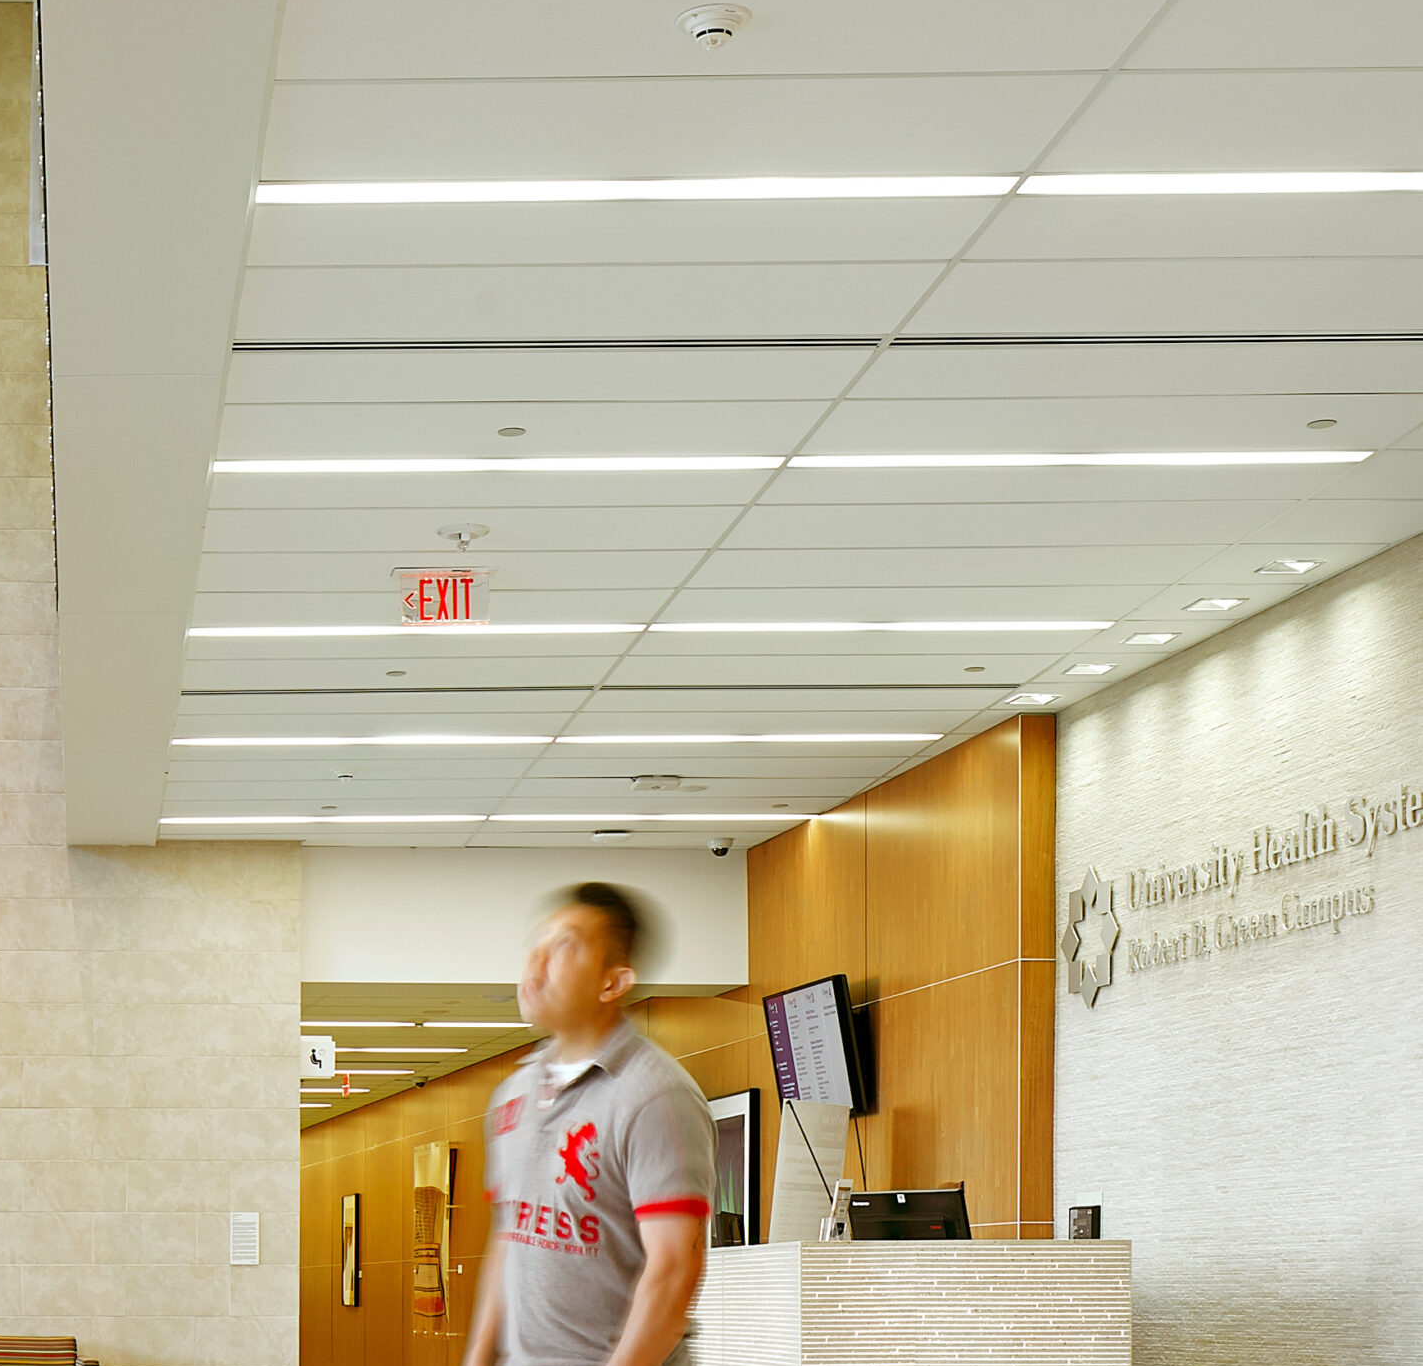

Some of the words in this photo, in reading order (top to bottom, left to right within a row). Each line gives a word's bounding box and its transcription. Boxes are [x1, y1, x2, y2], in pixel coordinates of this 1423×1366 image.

[418, 578, 474, 621] EXIT
[1127, 844, 1242, 911] University
[1249, 804, 1337, 876] Health
[1127, 929, 1188, 974] Robert
[1191, 916, 1211, 957] B.
[1214, 908, 1278, 951] Green
[1280, 885, 1376, 935] Campus
